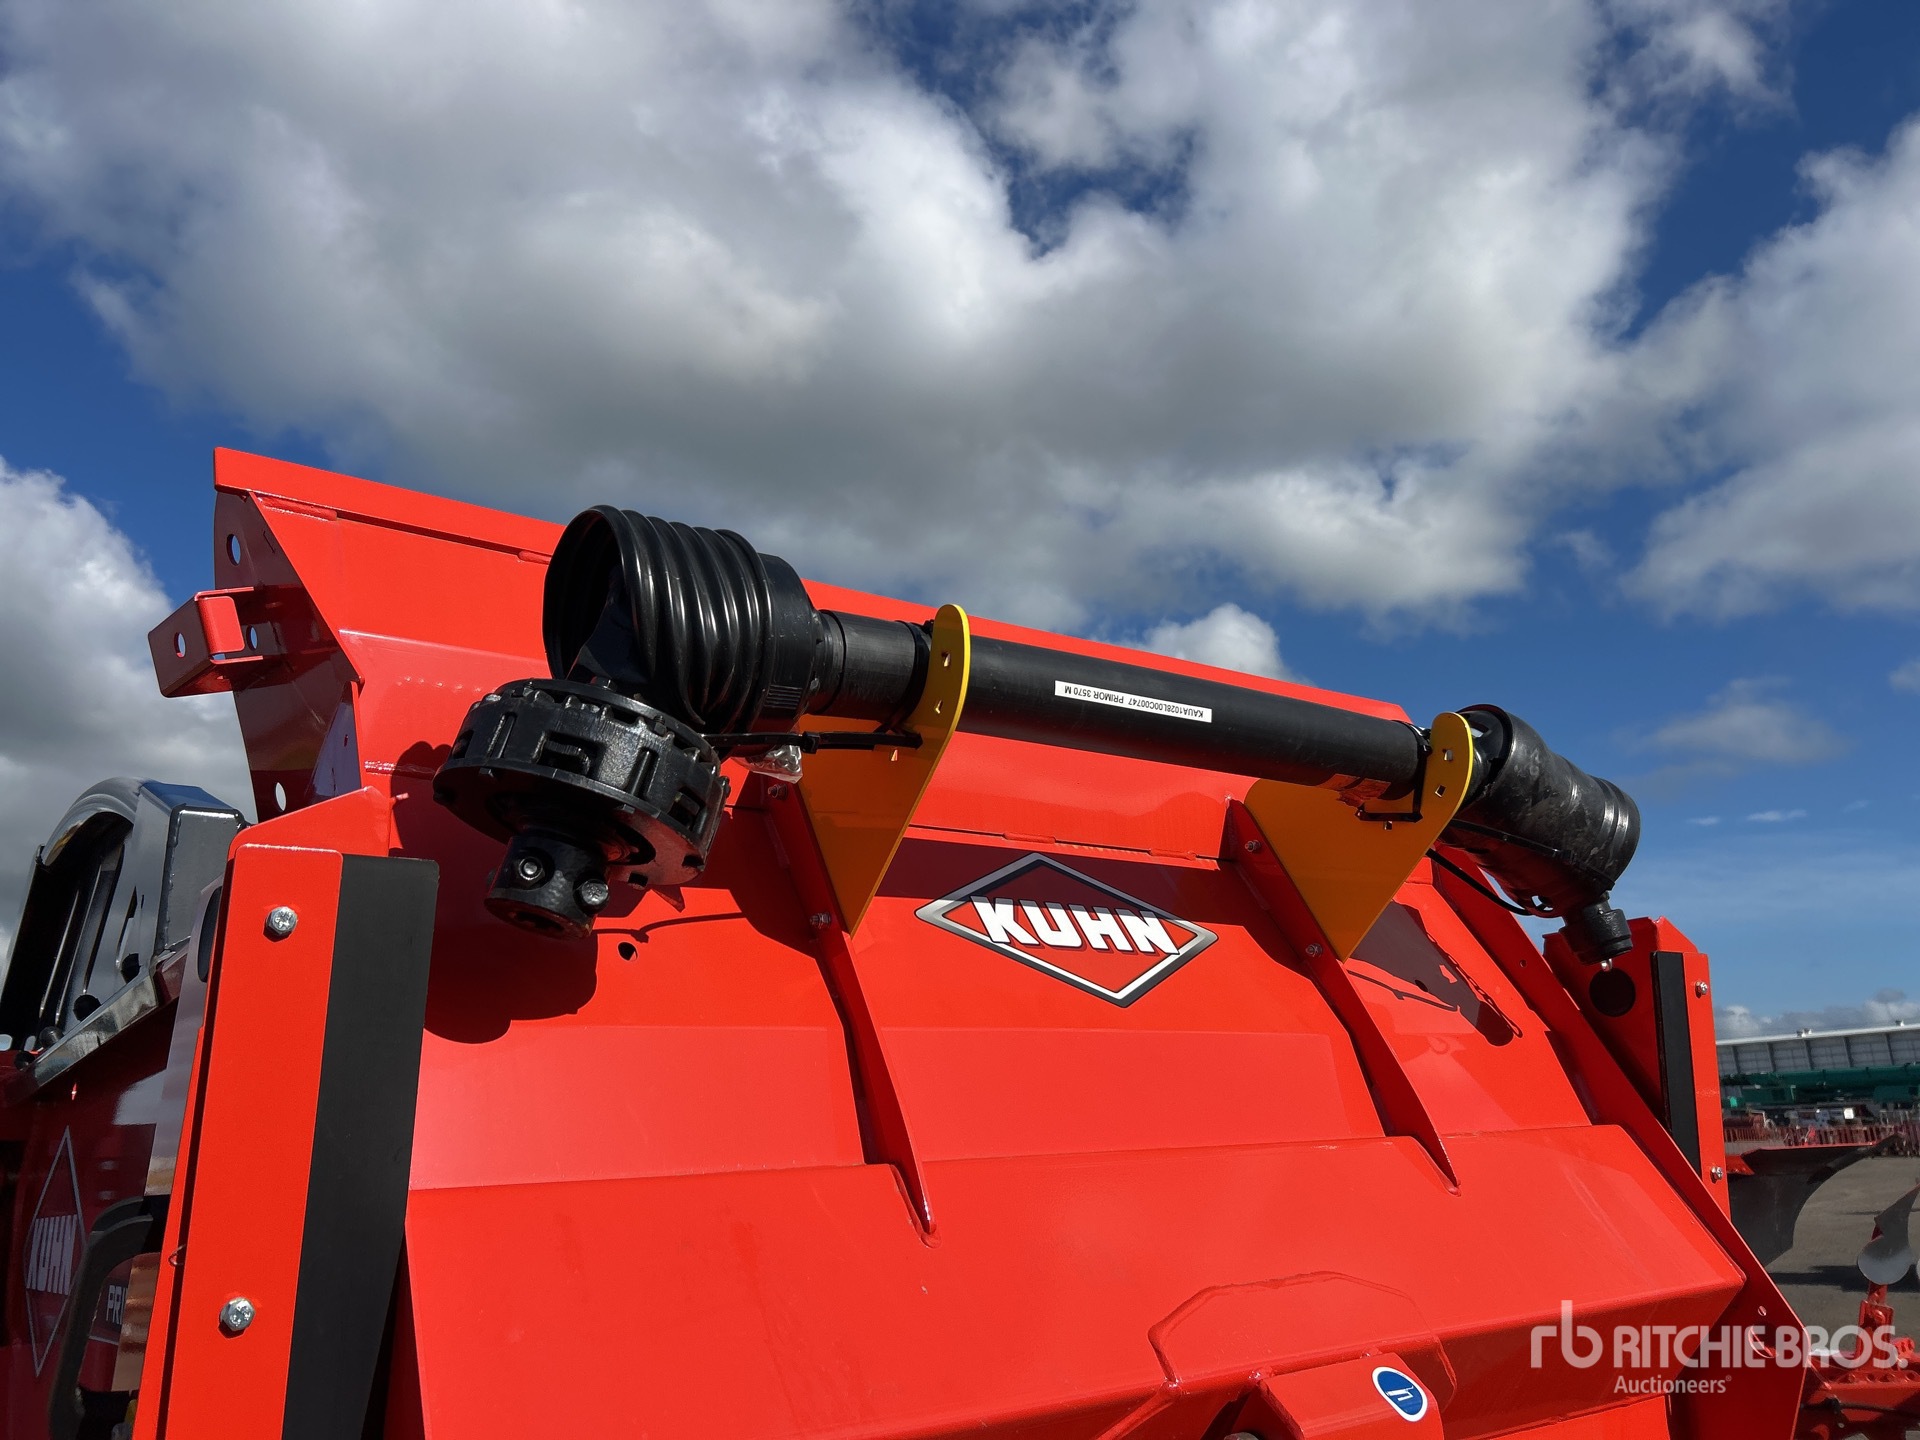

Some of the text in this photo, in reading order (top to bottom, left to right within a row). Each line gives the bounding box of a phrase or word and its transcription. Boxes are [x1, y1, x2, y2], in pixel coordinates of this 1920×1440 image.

[1064, 685, 1072, 695] M
[1073, 686, 1092, 698] 3570
[1093, 691, 1124, 704] PRIMOR
[969, 895, 1181, 955] KUHN
[26, 1213, 78, 1296] KUHN
[105, 1284, 128, 1325] PRI
